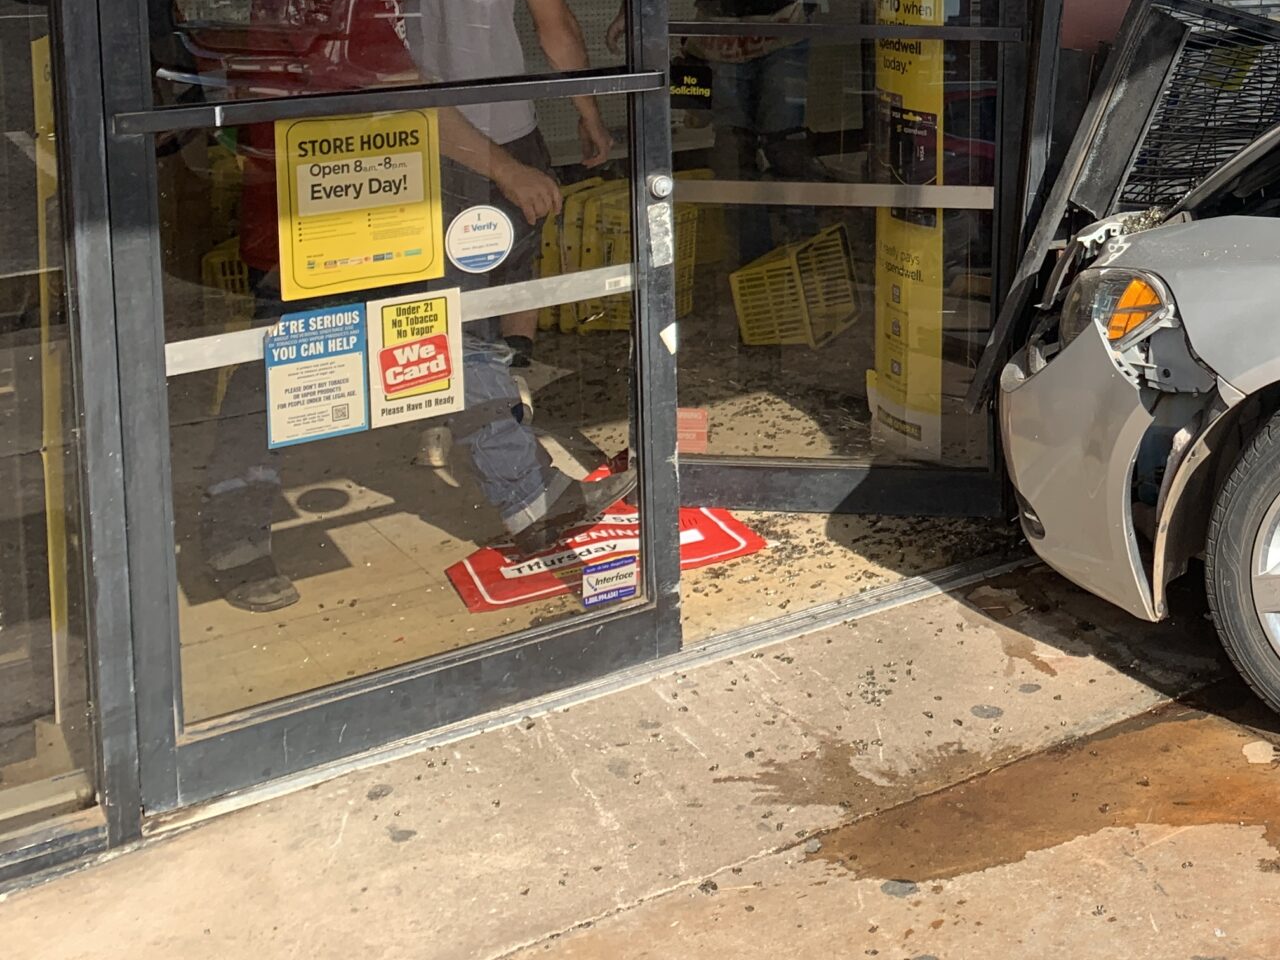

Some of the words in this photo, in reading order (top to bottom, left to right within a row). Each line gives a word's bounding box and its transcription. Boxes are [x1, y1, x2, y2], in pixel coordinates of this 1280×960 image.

[903, 1, 932, 16] when
[683, 75, 697, 85] No
[669, 86, 711, 98] Soliciting
[297, 136, 355, 158] STORE
[360, 129, 420, 151] HOURS
[310, 162, 350, 179] Open
[311, 181, 364, 201] Every
[368, 174, 408, 195] Day!
[396, 305, 421, 318] Under
[424, 302, 433, 313] 21
[309, 311, 360, 331] SERIOUS
[391, 318, 403, 329] No
[405, 313, 438, 328] Tobacco
[396, 328, 407, 339] No
[410, 324, 434, 337] Vapor
[272, 346, 296, 361] YOU
[300, 340, 324, 357] CAN
[328, 336, 358, 353] HELP
[393, 343, 436, 365] We
[385, 354, 446, 385] Card
[285, 384, 301, 394] PLEASE
[381, 404, 404, 417] Please
[406, 401, 423, 412] Have
[425, 399, 433, 409] ID
[434, 395, 454, 406] Ready
[512, 543, 617, 575] Thursday
[595, 572, 633, 586] Interface
